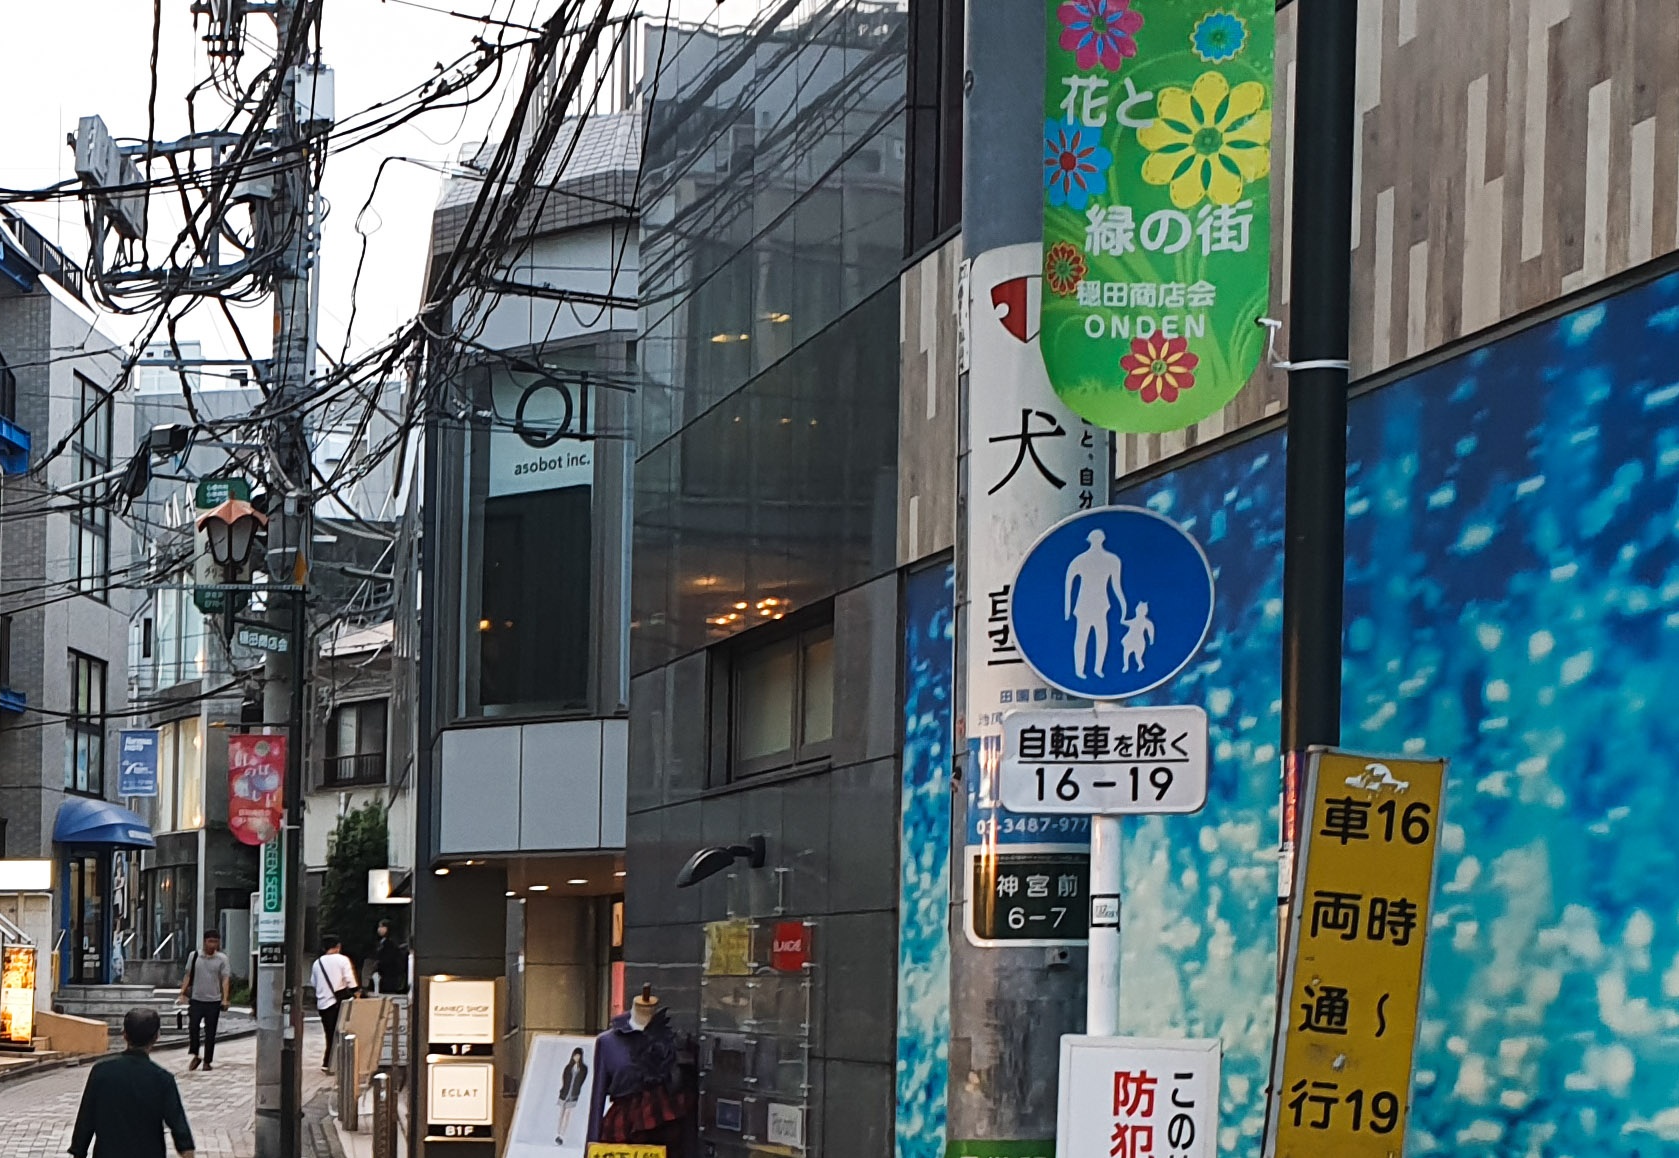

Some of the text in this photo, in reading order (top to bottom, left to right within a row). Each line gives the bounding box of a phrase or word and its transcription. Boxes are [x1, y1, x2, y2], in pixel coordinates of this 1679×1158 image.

[1060, 75, 1156, 129] 花と
[1083, 199, 1254, 257] 緑の街
[1084, 314, 1206, 339] ONDEN
[514, 452, 591, 476] asobot inc.
[1018, 724, 1190, 761] 自転車を除く
[976, 816, 1090, 836] 03-3487-977
[996, 874, 1080, 898] 神宮前
[450, 1044, 472, 1056] 1F
[441, 1088, 479, 1098] ECLAT
